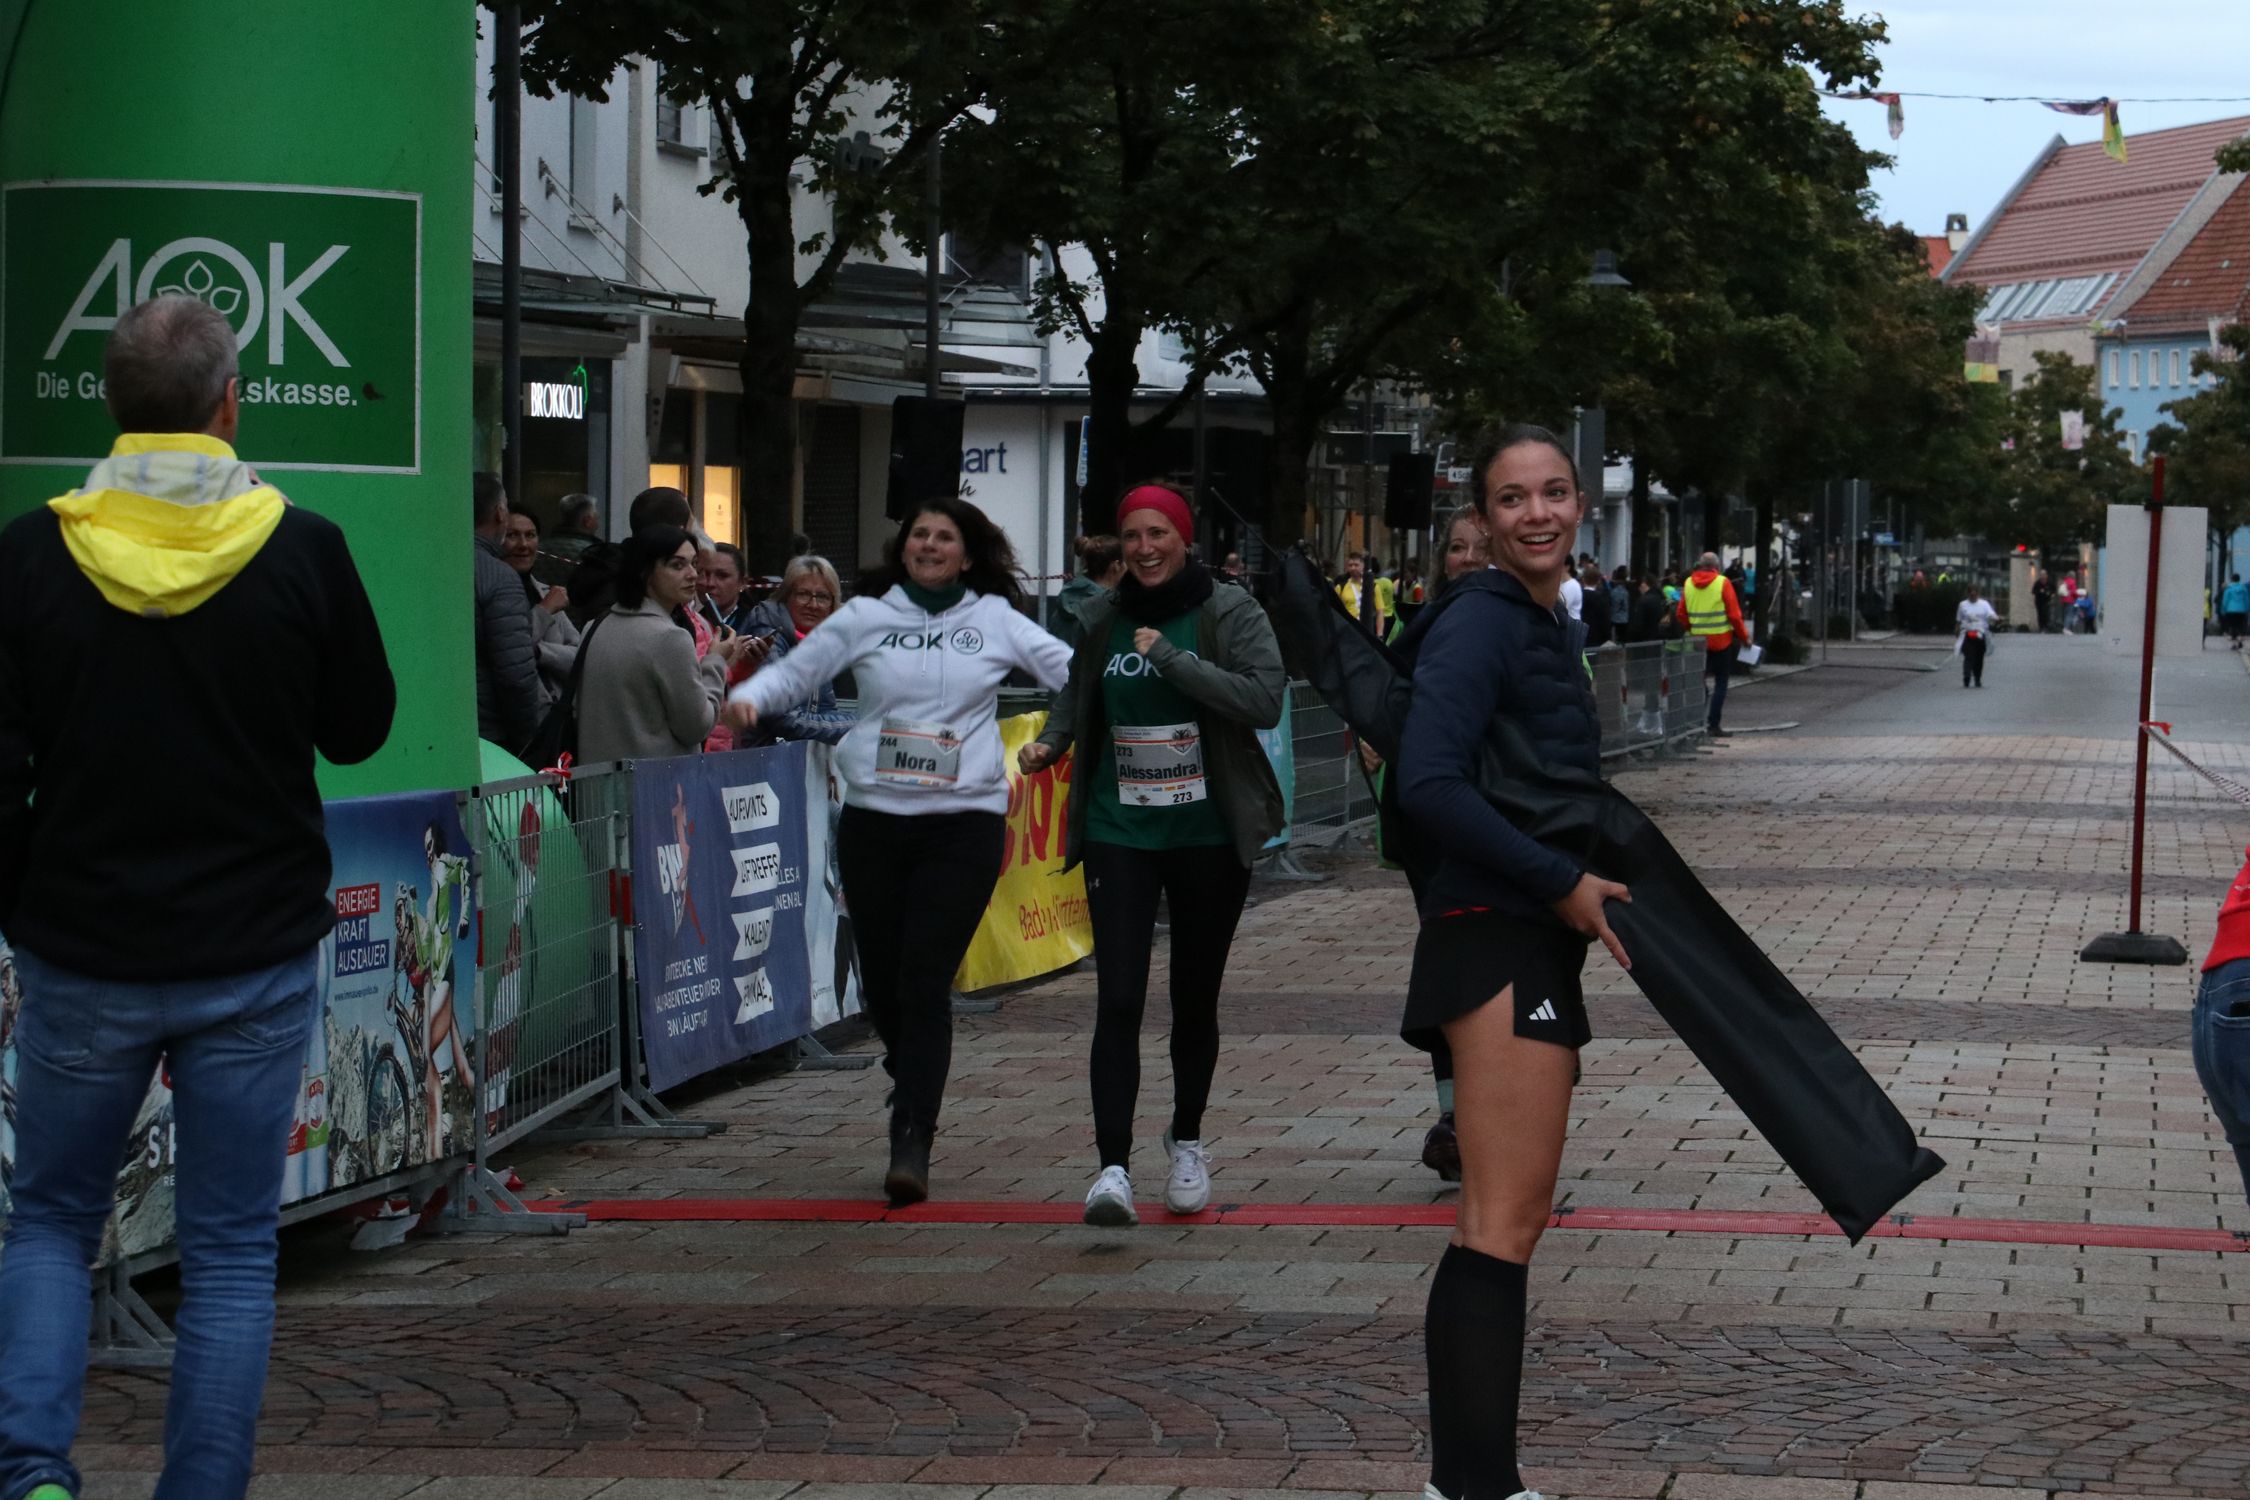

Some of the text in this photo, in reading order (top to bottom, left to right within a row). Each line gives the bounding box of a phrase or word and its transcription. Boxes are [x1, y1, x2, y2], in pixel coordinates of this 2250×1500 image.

[43, 236, 351, 367] AOK
[36, 370, 70, 399] Die
[531, 382, 583, 419] BROKKOLI
[960, 441, 1007, 474] art
[876, 631, 944, 651] AOK
[1103, 652, 1163, 678] AOK
[880, 736, 897, 748] 244
[1116, 746, 1133, 757] 273
[894, 751, 937, 772] Nora
[1119, 763, 1198, 780] Alessandra
[1173, 791, 1193, 804] 273
[338, 918, 367, 944] KRAFT
[337, 944, 387, 973] AUSDAUER
